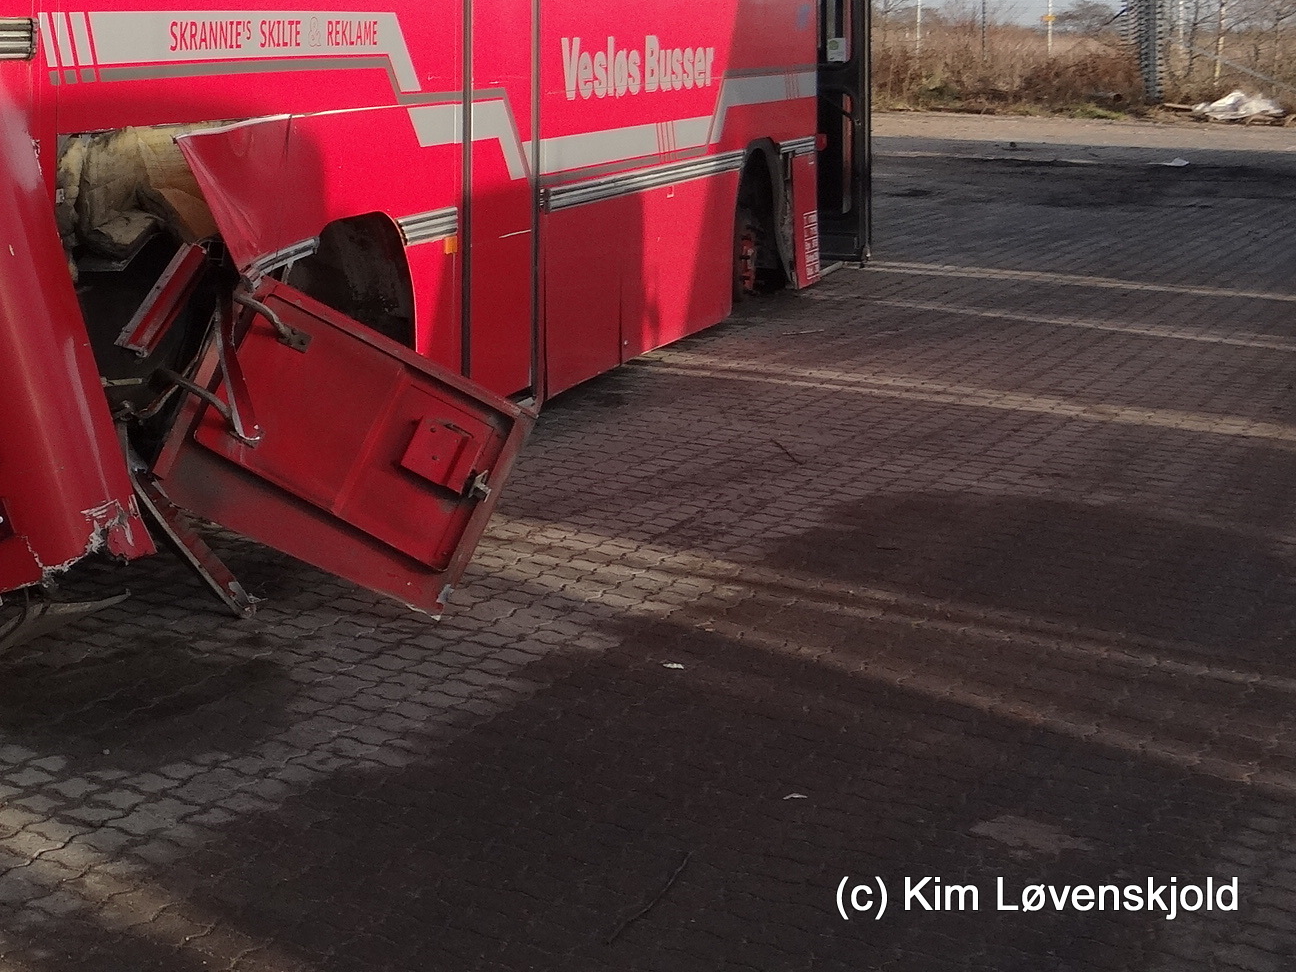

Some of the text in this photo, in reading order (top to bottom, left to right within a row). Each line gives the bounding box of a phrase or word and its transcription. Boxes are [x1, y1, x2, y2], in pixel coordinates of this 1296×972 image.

[169, 19, 253, 52] SKRANNIE'S
[260, 19, 301, 49] SKILTE
[327, 20, 378, 46] REKLAME
[561, 35, 714, 101] Vesløs Busser
